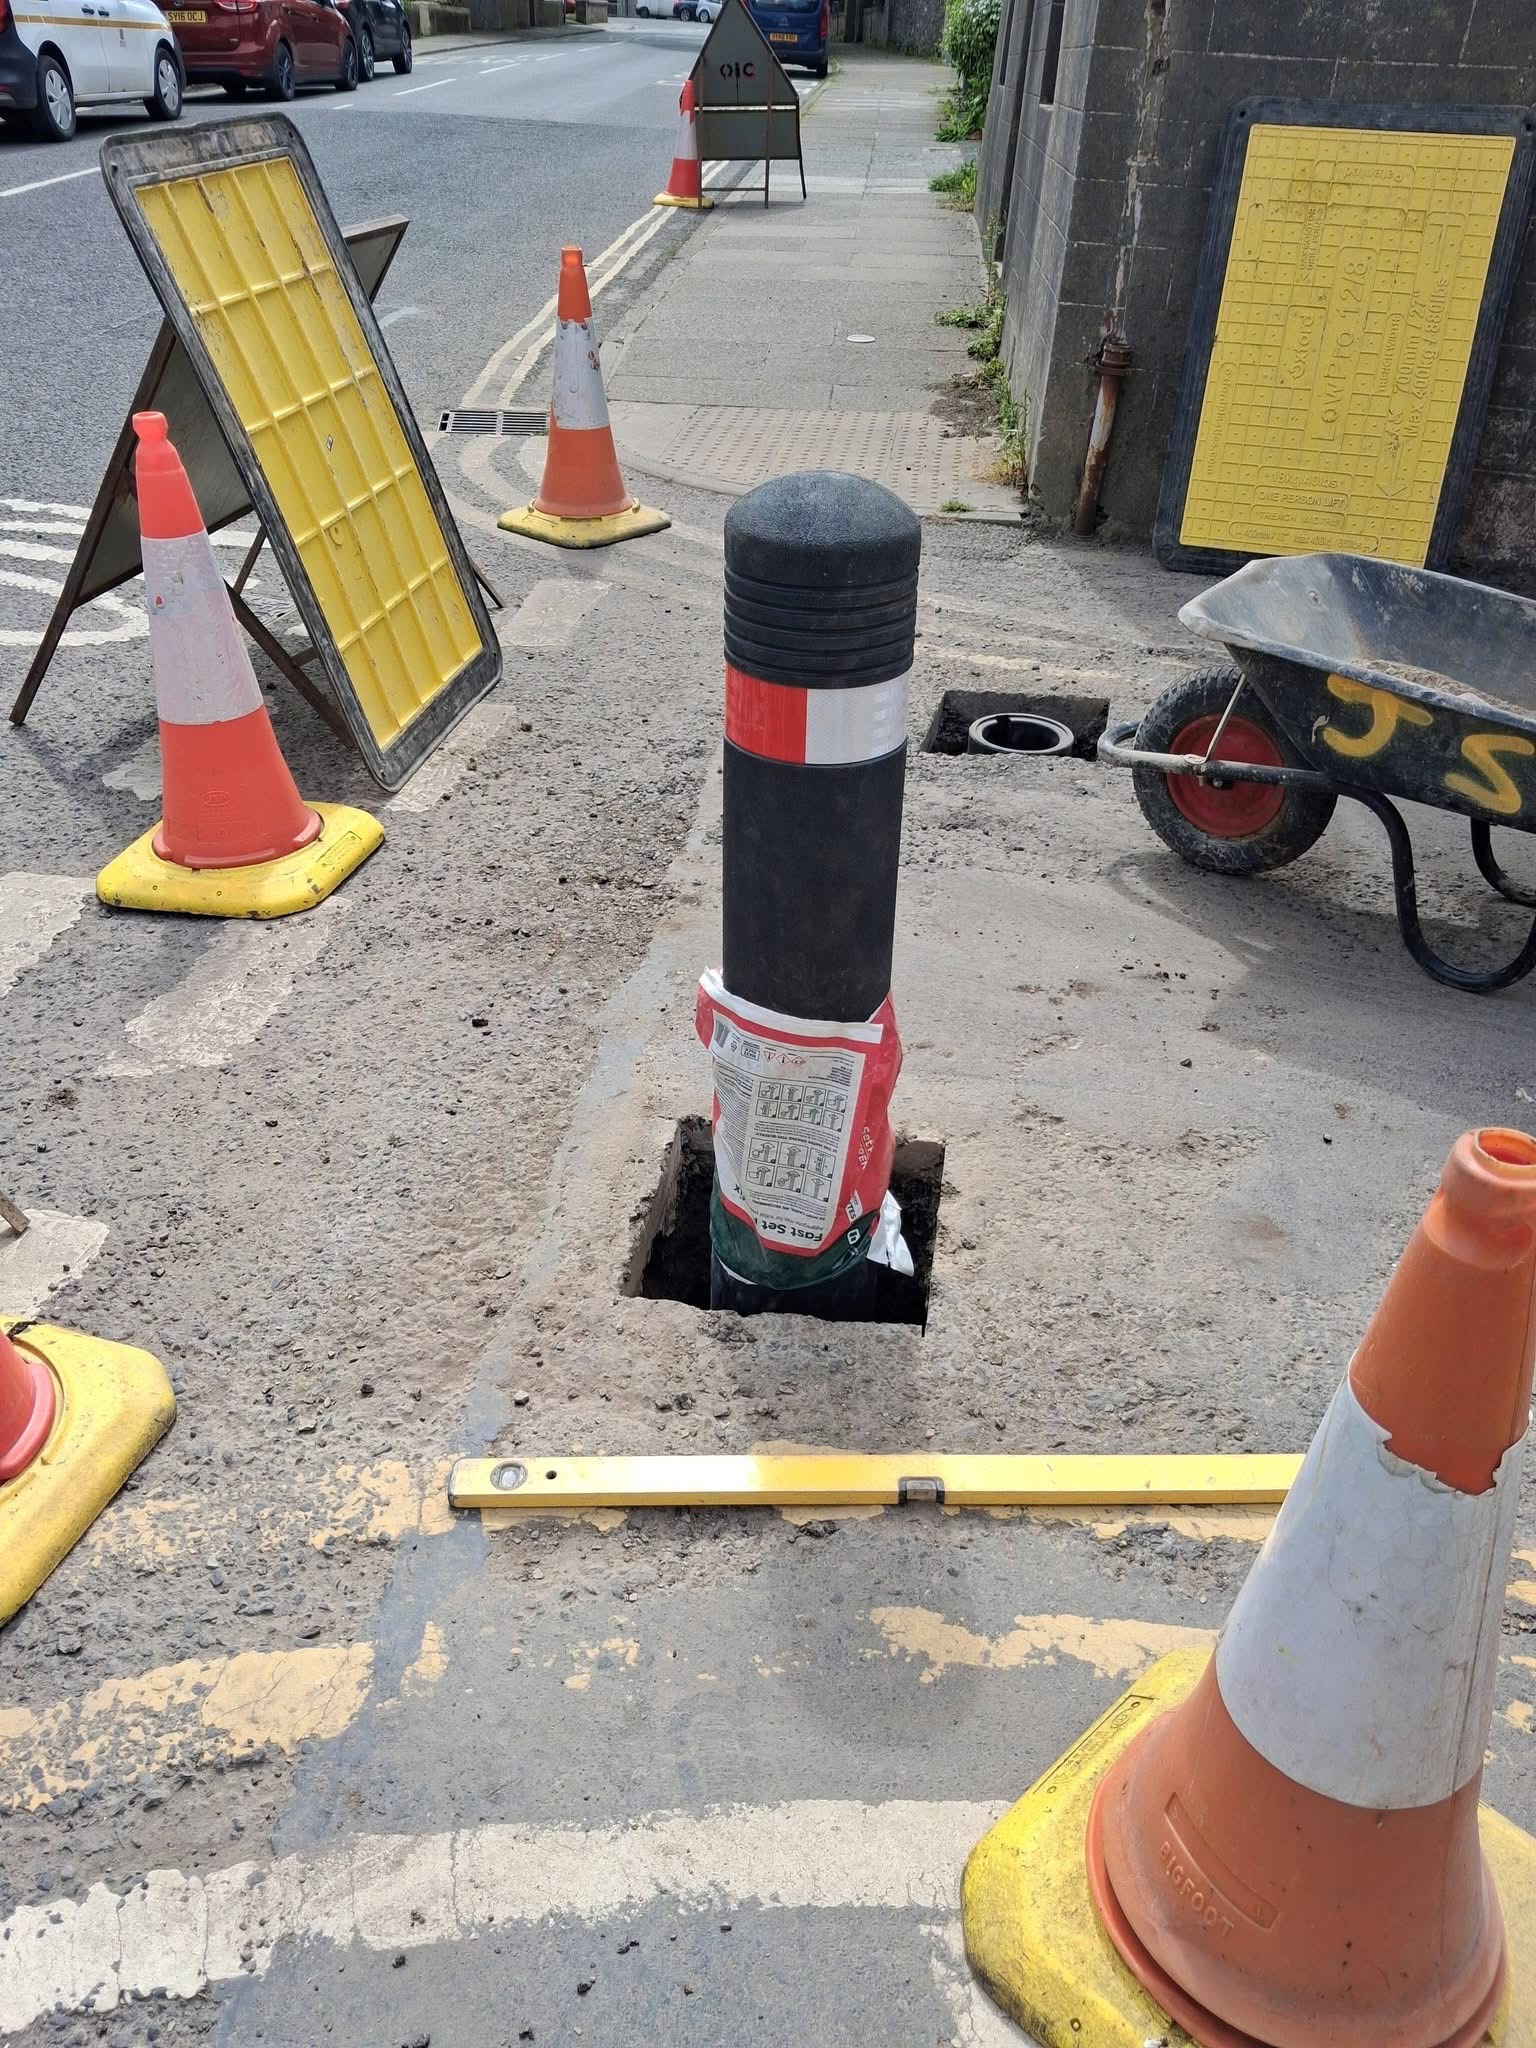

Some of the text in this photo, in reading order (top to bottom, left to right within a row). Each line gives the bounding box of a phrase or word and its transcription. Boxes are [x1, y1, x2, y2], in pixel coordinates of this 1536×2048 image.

[167, 11, 186, 21] SY16
[1424, 278, 1449, 334] 880lbs
[1385, 316, 1401, 352] WIDTH
[1393, 336, 1420, 394] 700mm
[1411, 349, 1440, 399] 400kg
[1402, 404, 1424, 438] Max
[1259, 491, 1346, 509] ONE PERSON LIFT
[761, 1220, 823, 1242] Fast Set
[1160, 1840, 1235, 1937] BIGFOOT
